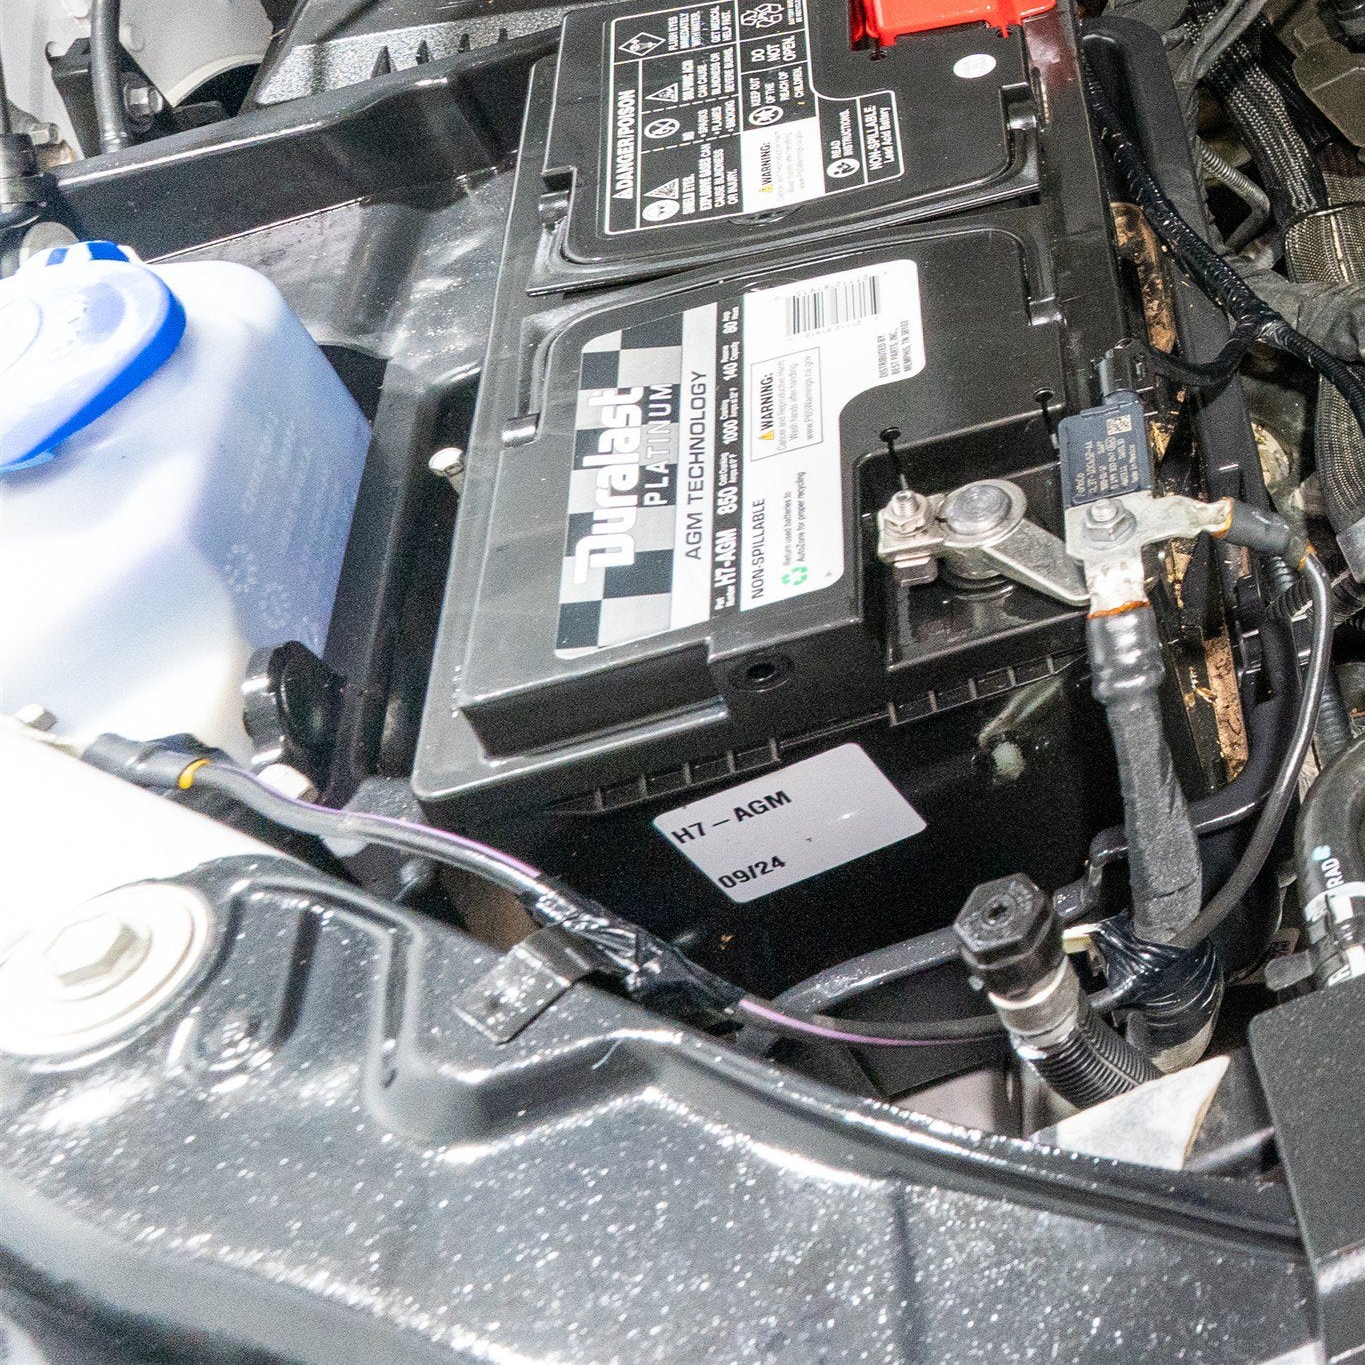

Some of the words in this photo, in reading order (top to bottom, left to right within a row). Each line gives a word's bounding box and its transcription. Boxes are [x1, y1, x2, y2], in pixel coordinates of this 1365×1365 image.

[751, 48, 765, 62] DO
[766, 44, 781, 61] NOT
[781, 35, 797, 61] OPEN.
[750, 77, 761, 89] OUT
[779, 81, 790, 101] REACH
[751, 89, 762, 107] KEEP
[879, 107, 891, 131] Battery
[615, 89, 635, 191] DANGER/POISON
[830, 140, 842, 160] READ
[863, 105, 883, 170] NON-SPILLABLE
[881, 132, 892, 146] Acid
[760, 142, 772, 187] WARNING:
[882, 146, 895, 163] Lead
[722, 320, 738, 334] 80
[722, 362, 738, 380] 140
[760, 372, 774, 431] WARNING:
[644, 383, 672, 507] PLATINUM
[687, 371, 706, 505] TECHNOLOGY
[722, 419, 738, 444] 1000
[573, 386, 644, 585] Duralast
[795, 471, 806, 499] recycling
[716, 485, 738, 515] 850
[782, 499, 792, 527] batteries
[796, 500, 806, 520] proper
[685, 512, 703, 560] AGM
[782, 528, 792, 543] used
[796, 522, 805, 530] for
[714, 527, 737, 587] H7-AGM
[751, 498, 765, 599] NON-SPILLABLE
[782, 544, 792, 566] Return
[796, 531, 805, 562] AutoZone
[671, 821, 706, 844] H7
[734, 790, 792, 823] AGM
[717, 855, 786, 889] 09/24
[1320, 857, 1345, 890] RAD
